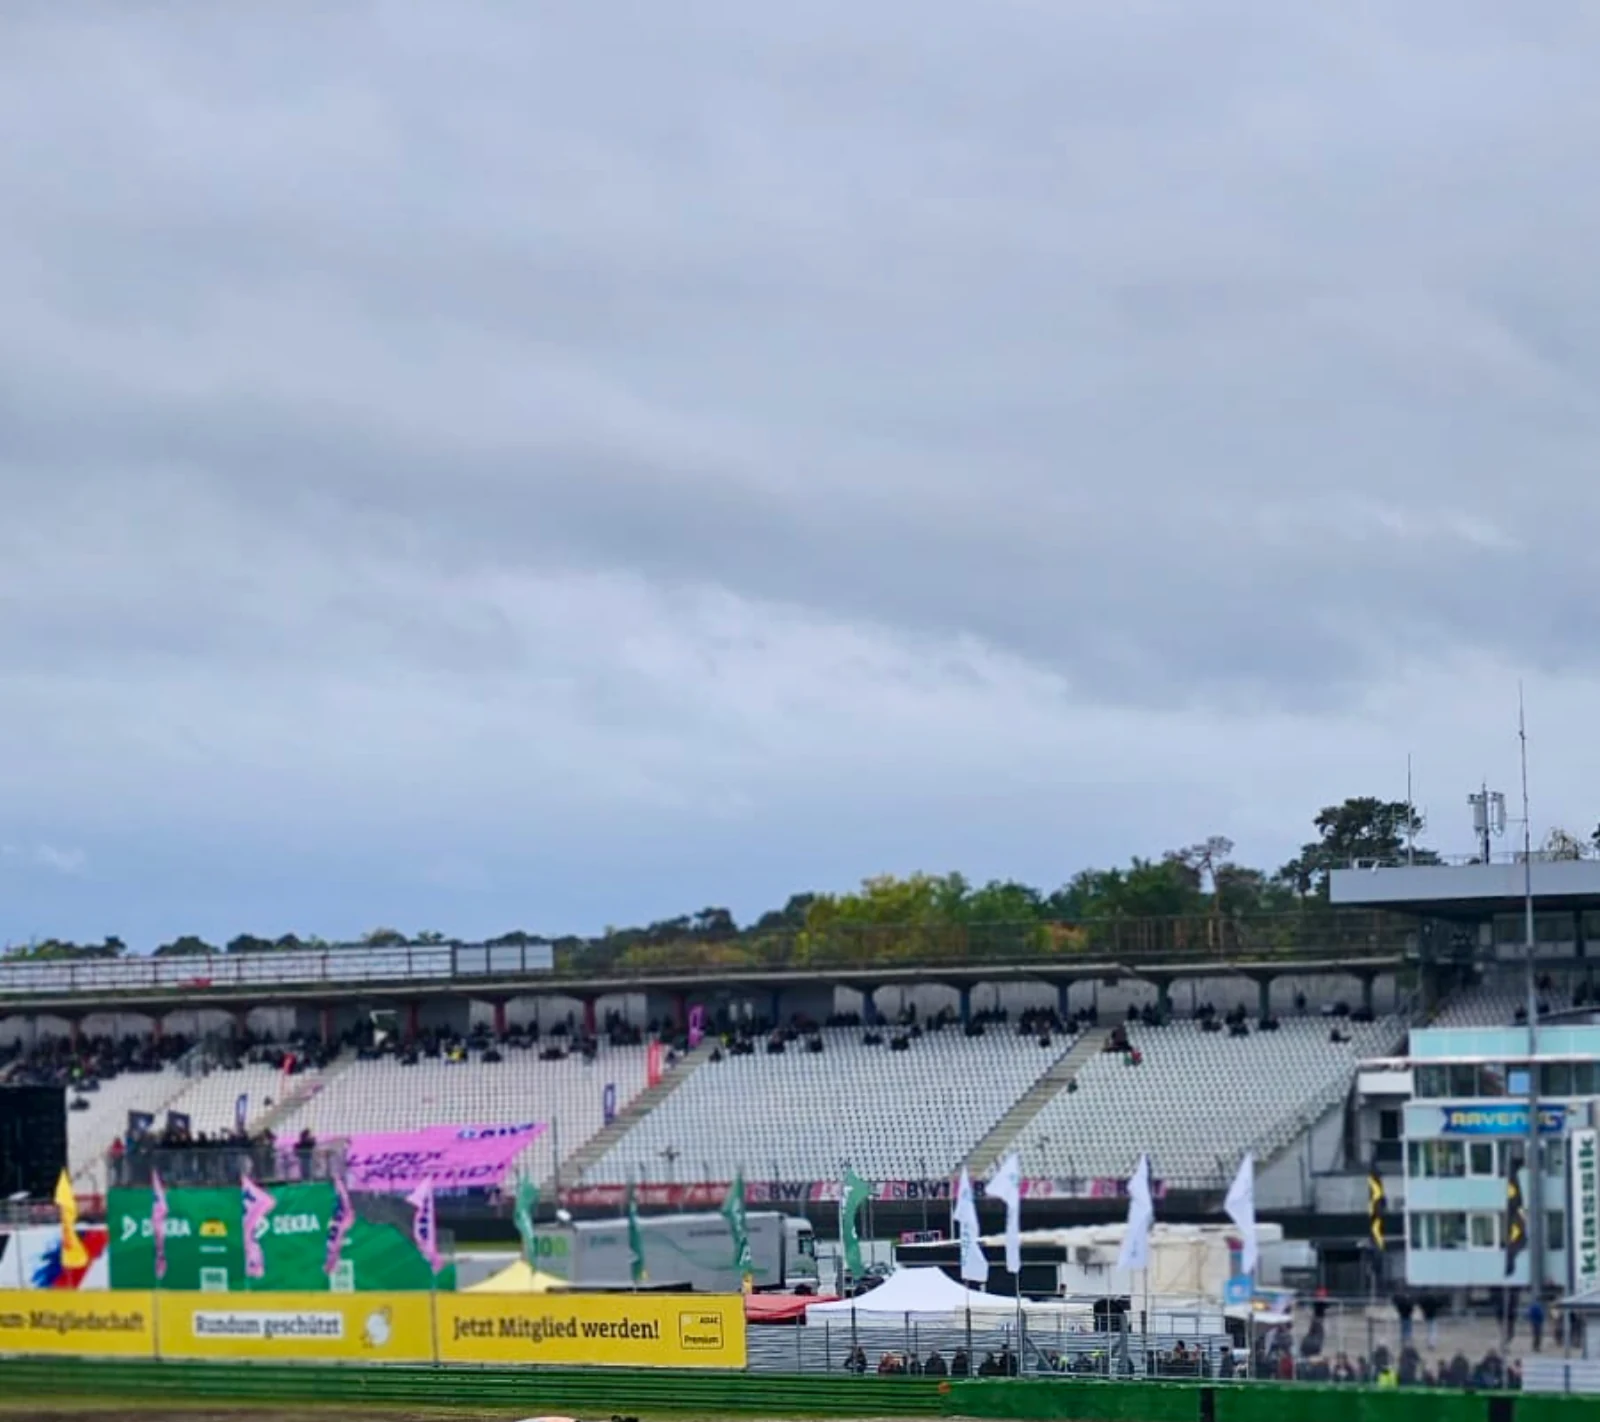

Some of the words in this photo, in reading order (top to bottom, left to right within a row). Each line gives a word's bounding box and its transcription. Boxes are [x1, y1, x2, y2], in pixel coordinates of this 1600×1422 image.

[141, 1217, 192, 1237] DKRA
[273, 1214, 320, 1234] DEKRA
[196, 1314, 260, 1333] Rundum
[264, 1314, 340, 1340] geschützt
[453, 1316, 495, 1341] Jetzt
[499, 1317, 577, 1343] Mitglied
[581, 1317, 660, 1340] werden!
